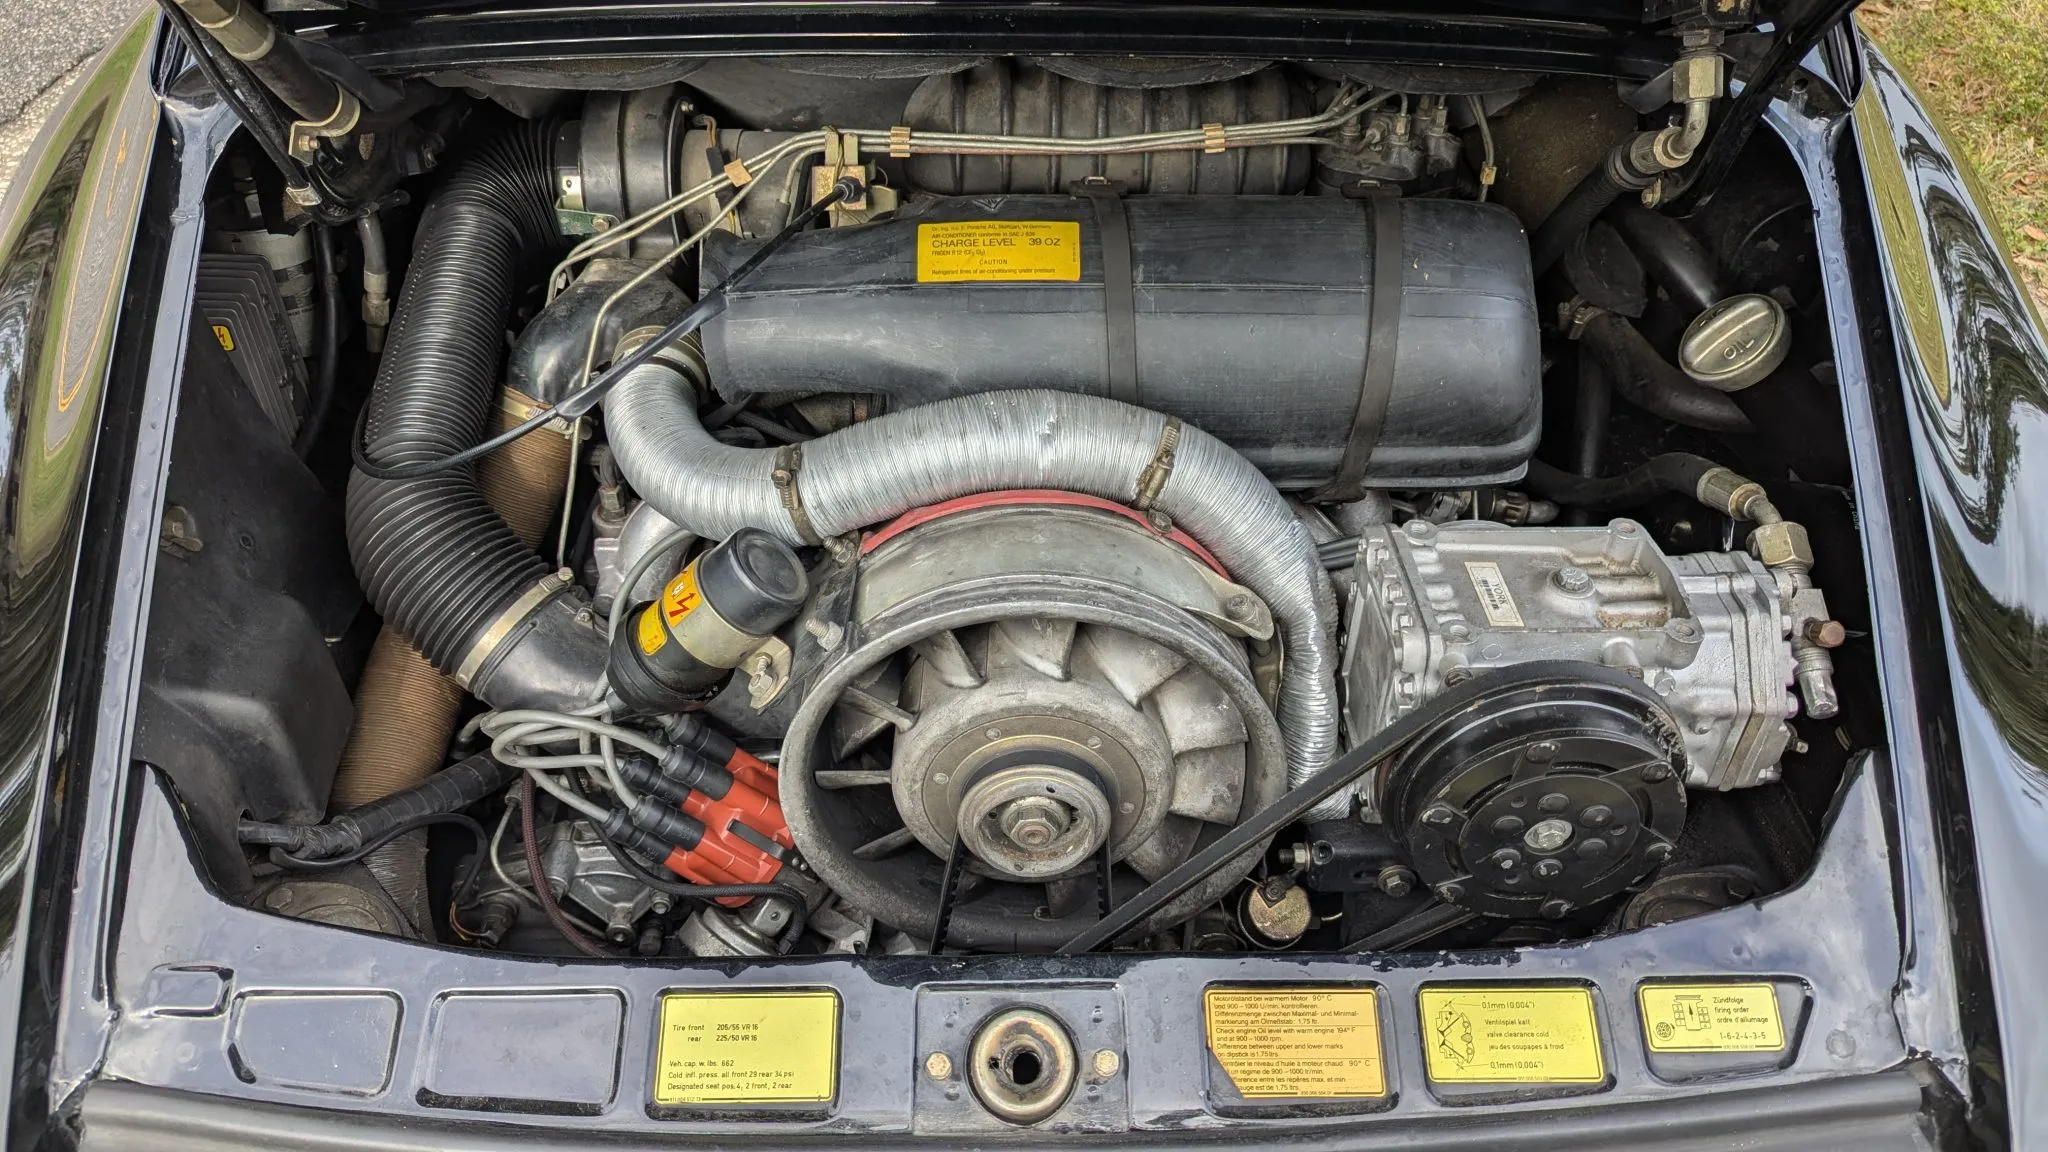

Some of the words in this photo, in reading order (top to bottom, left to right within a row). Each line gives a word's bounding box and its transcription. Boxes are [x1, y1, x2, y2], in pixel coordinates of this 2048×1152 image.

[932, 238, 980, 248] CHARGE
[983, 238, 1017, 247] LEVEL
[1028, 237, 1042, 246] 39
[1045, 237, 1061, 246] OZ
[1723, 339, 1755, 360] OIL
[1491, 582, 1508, 605] YORK
[1714, 1007, 1732, 1015] firing
[1719, 1032, 1766, 1040] 1-6-2-4-3-5
[668, 1083, 704, 1091] Designated
[751, 1082, 770, 1090] front,
